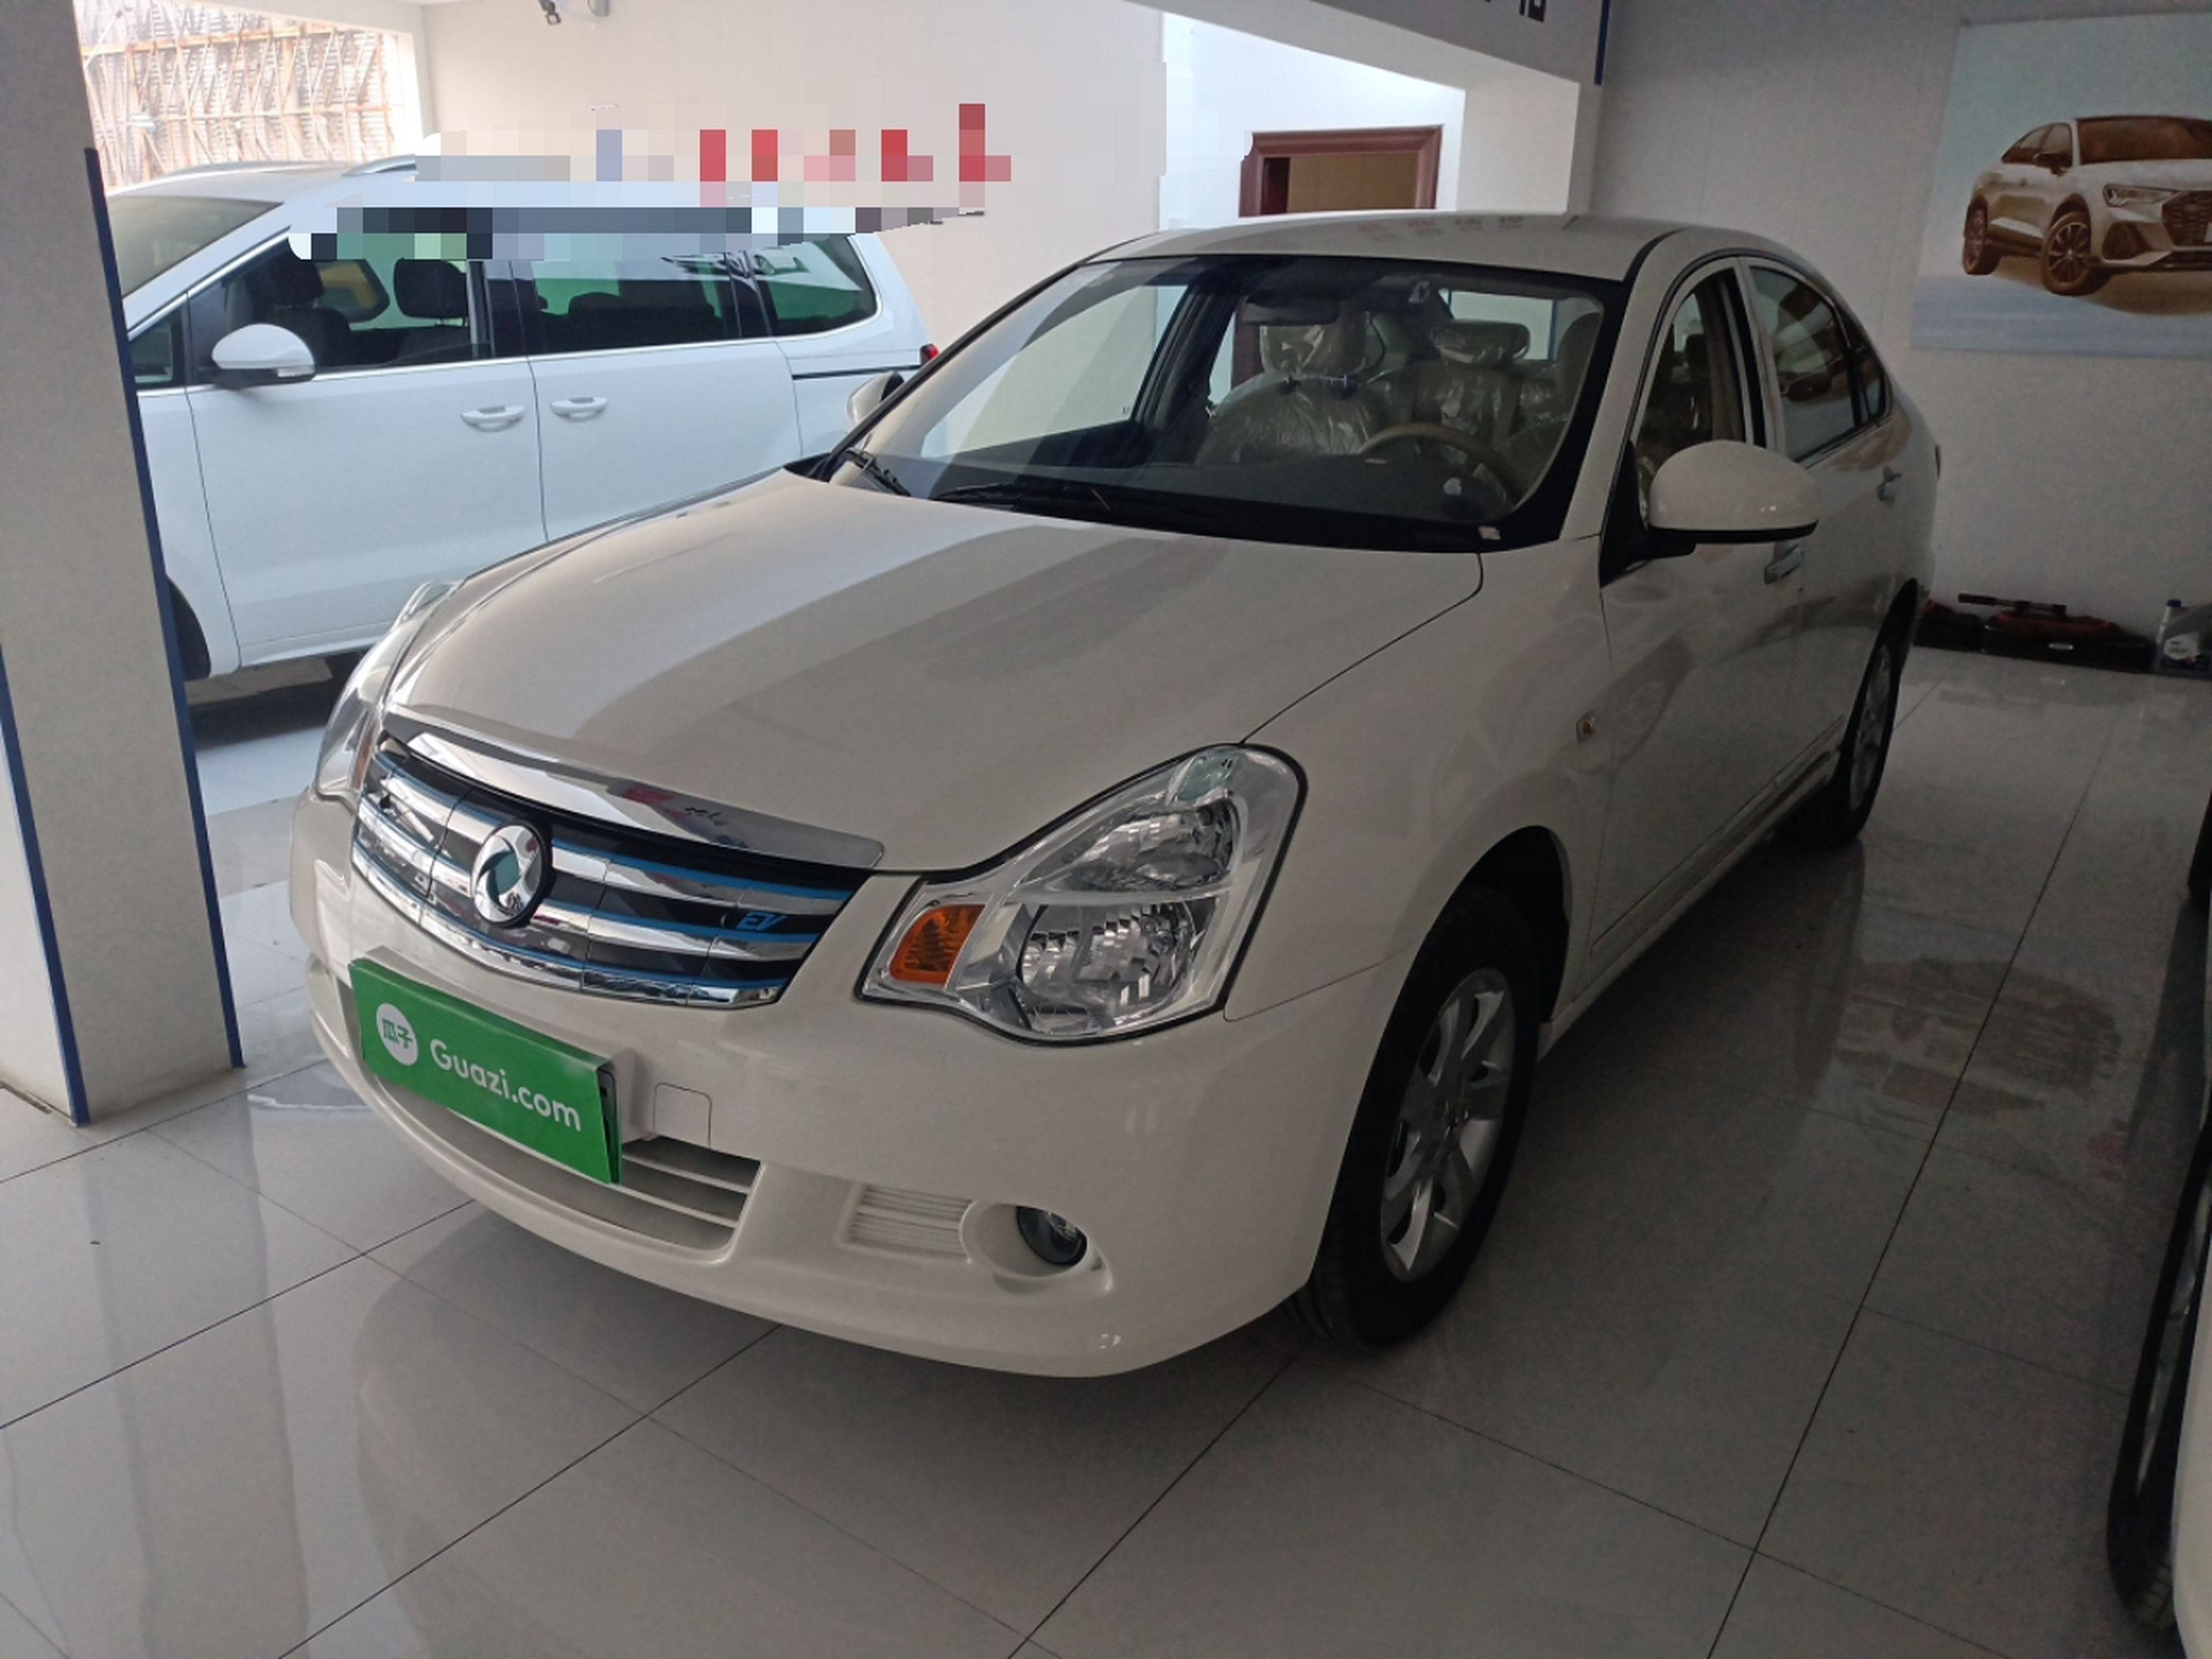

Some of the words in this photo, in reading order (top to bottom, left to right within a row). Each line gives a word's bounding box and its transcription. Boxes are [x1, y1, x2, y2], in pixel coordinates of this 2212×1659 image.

[736, 911, 789, 931] EV
[382, 1018, 413, 1049] 瓜子
[430, 1039, 581, 1131] Guazi.com
